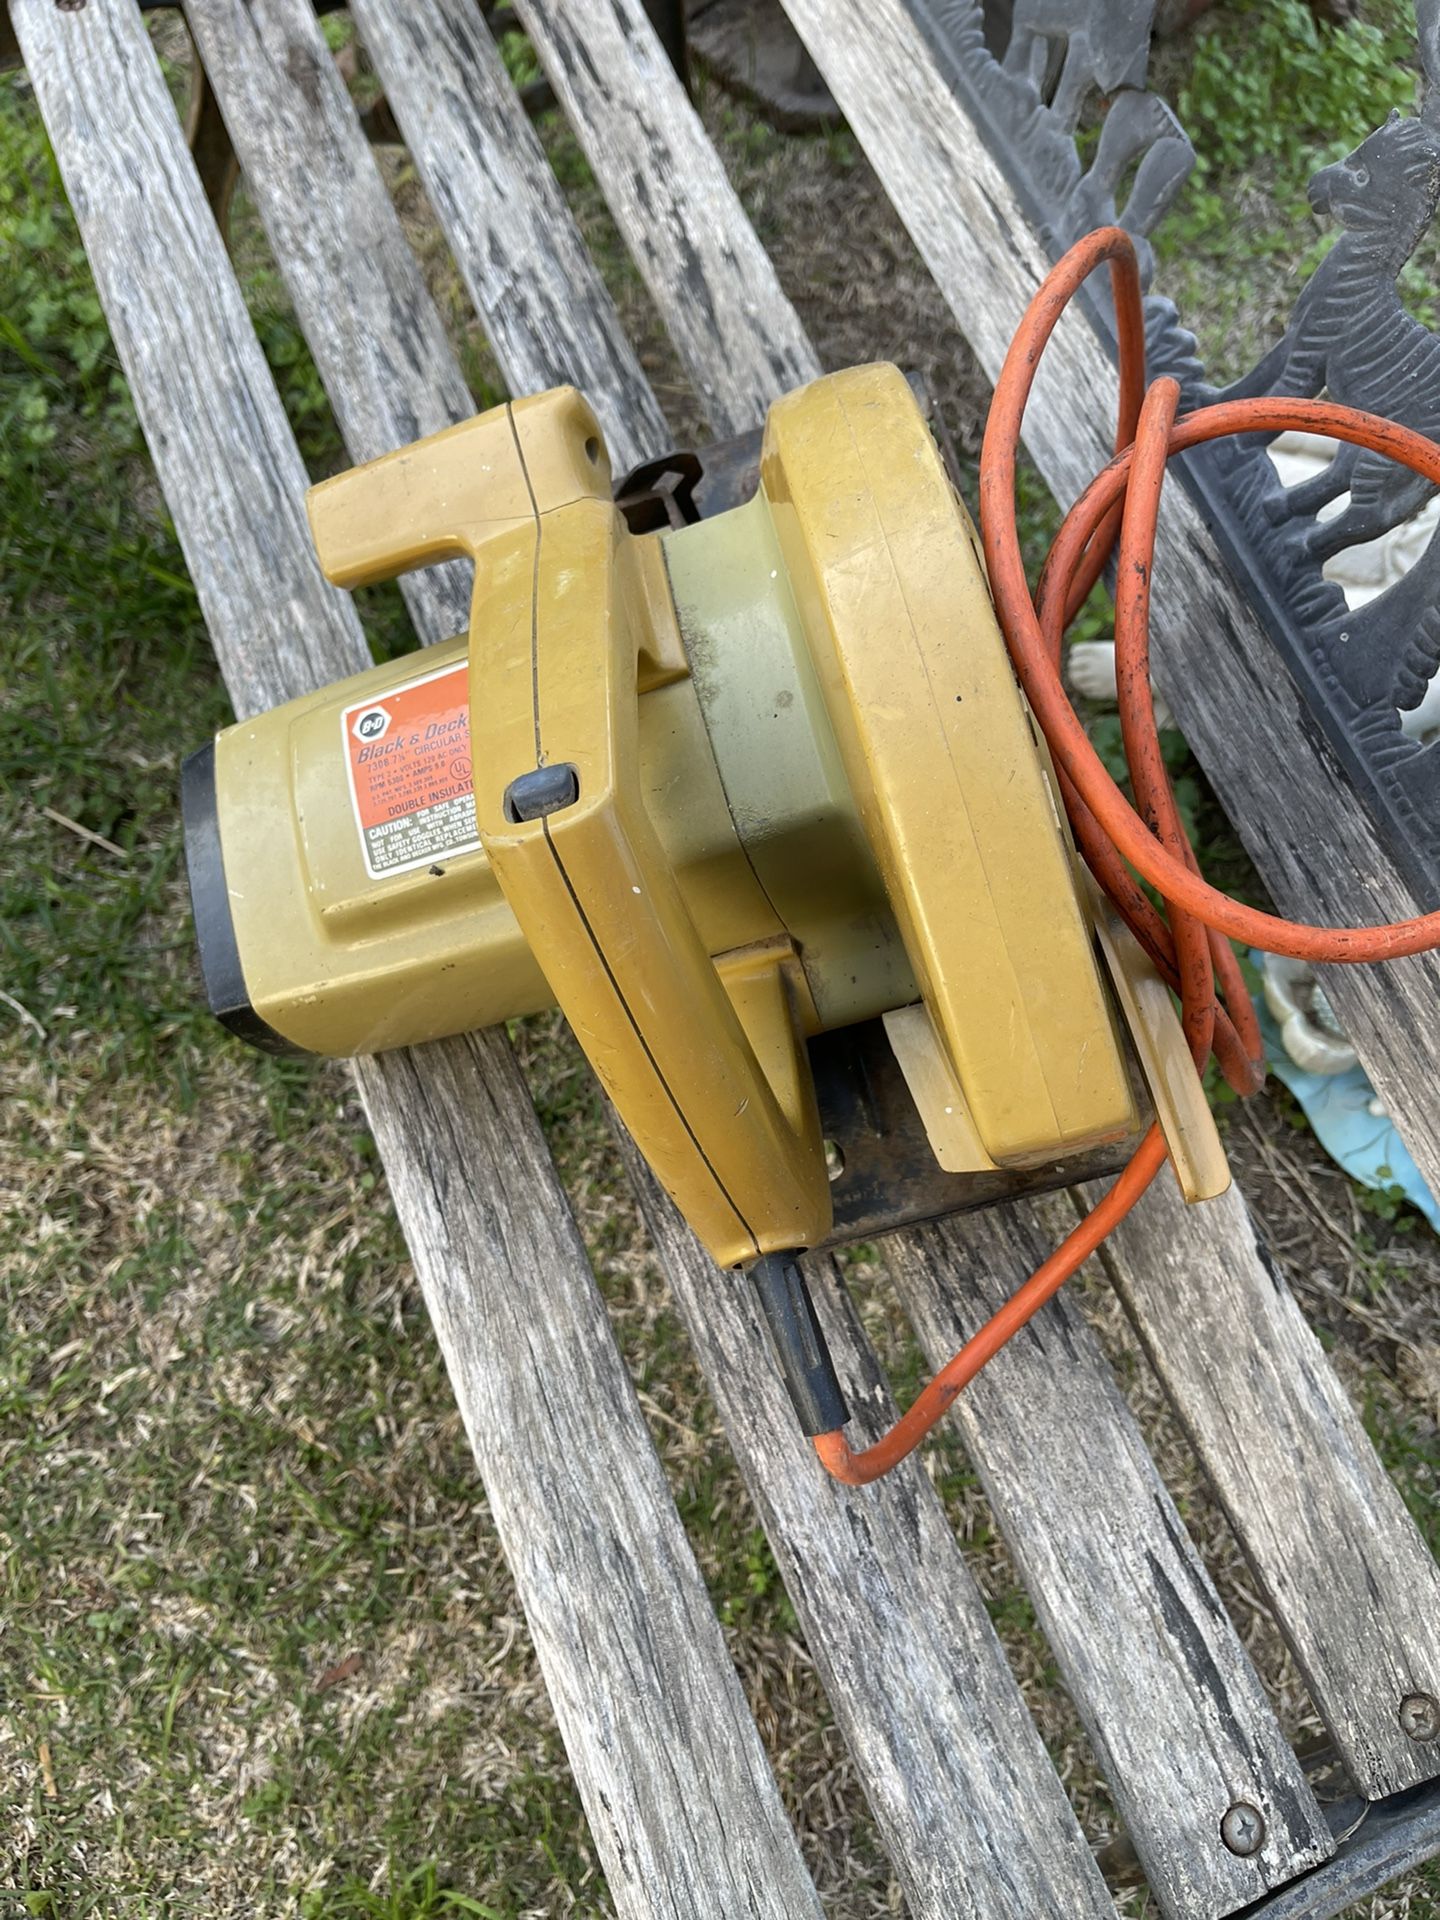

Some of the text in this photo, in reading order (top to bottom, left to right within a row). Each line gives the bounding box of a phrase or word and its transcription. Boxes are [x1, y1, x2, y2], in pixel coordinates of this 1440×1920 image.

[358, 735, 405, 764] Black
[409, 733, 419, 746] &
[414, 732, 461, 756] CIRCULAR
[369, 772, 384, 783] TYPE
[400, 761, 421, 772] VOLTS
[438, 752, 447, 760] AC
[449, 744, 467, 756] ONLY
[370, 781, 385, 791] RPM
[413, 765, 433, 776] AMPS
[388, 795, 426, 816] DOUBLE
[428, 778, 474, 802] INSULAT
[369, 817, 413, 840] CAUTION:
[416, 808, 430, 818] FOR
[433, 801, 450, 812] SAFE
[419, 805, 462, 825] INSTRUCTION
[371, 839, 385, 848] NOT
[390, 832, 403, 843] FOR
[408, 826, 420, 836] USE
[426, 819, 444, 830] WITH
[373, 847, 385, 857] USE
[387, 838, 410, 851] SAFETY
[411, 828, 441, 843] GOGGLES
[442, 820, 463, 832] WHEN
[375, 823, 478, 864] ONLY IDENTICAL REPLACEME
[383, 857, 400, 867] BLACK
